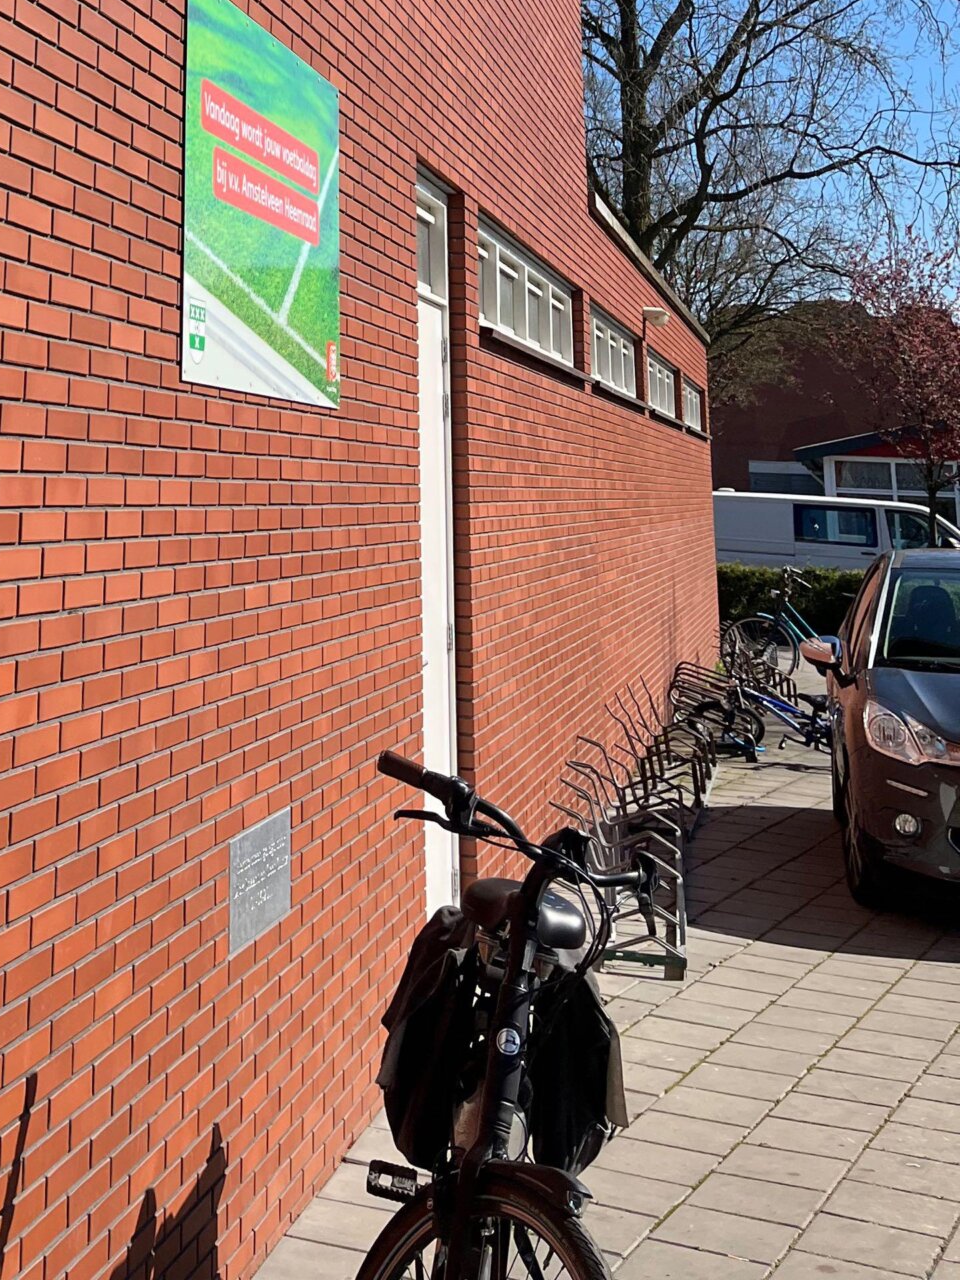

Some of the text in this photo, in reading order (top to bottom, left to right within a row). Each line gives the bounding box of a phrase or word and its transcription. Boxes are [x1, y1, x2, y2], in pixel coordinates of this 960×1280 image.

[204, 91, 317, 187] Vandaag wordt jouw voetbaldag
[216, 158, 316, 232] bij v.v. Amstelveen Heemraad
